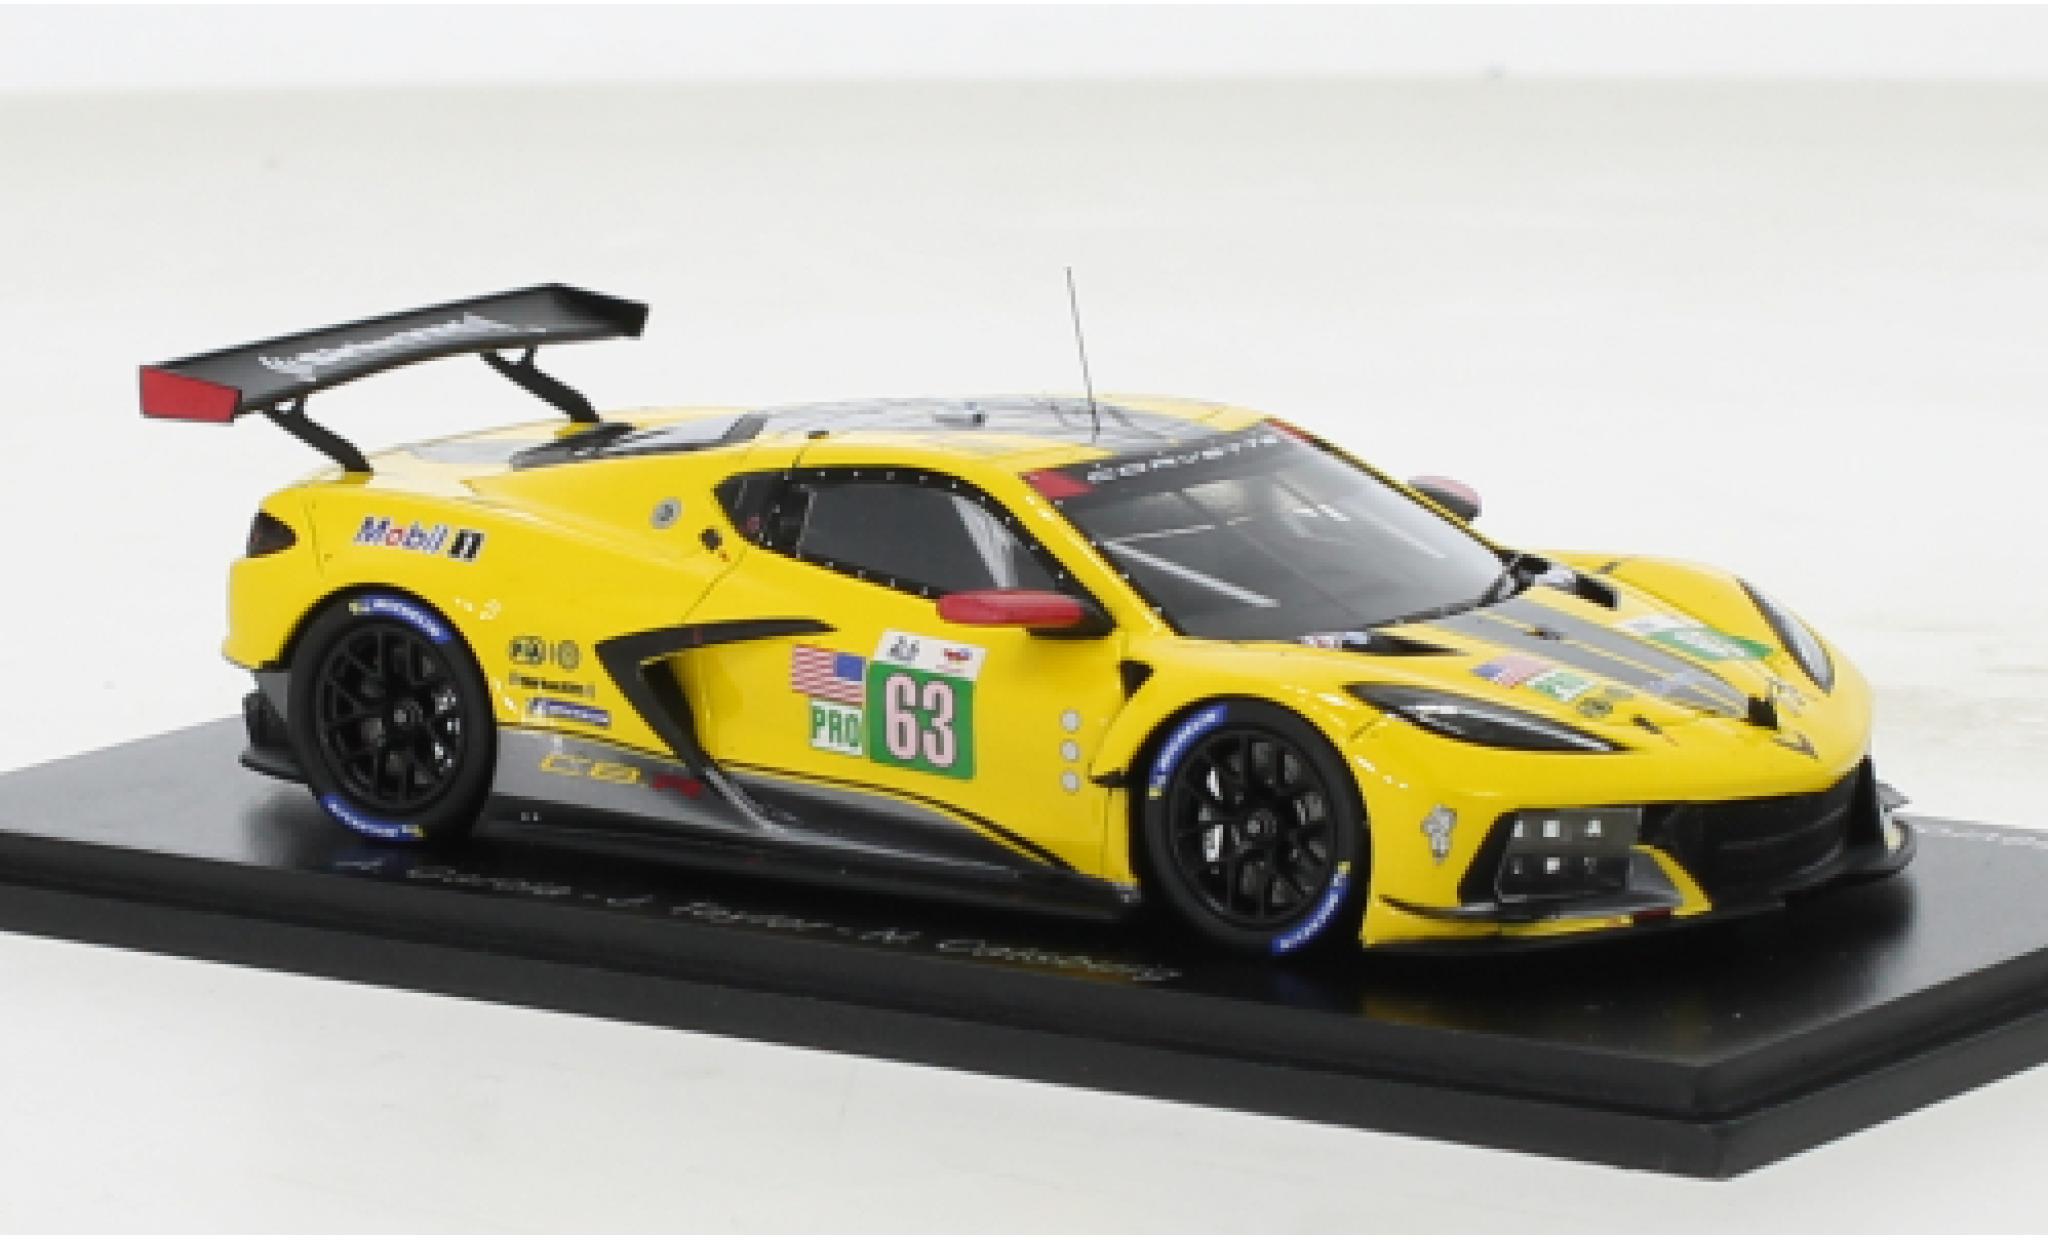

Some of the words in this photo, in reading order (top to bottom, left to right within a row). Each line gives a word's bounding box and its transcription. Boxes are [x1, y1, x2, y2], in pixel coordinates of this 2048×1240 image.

[353, 515, 448, 554] Mobil
[811, 705, 861, 749] PRO
[883, 672, 956, 769] 63
